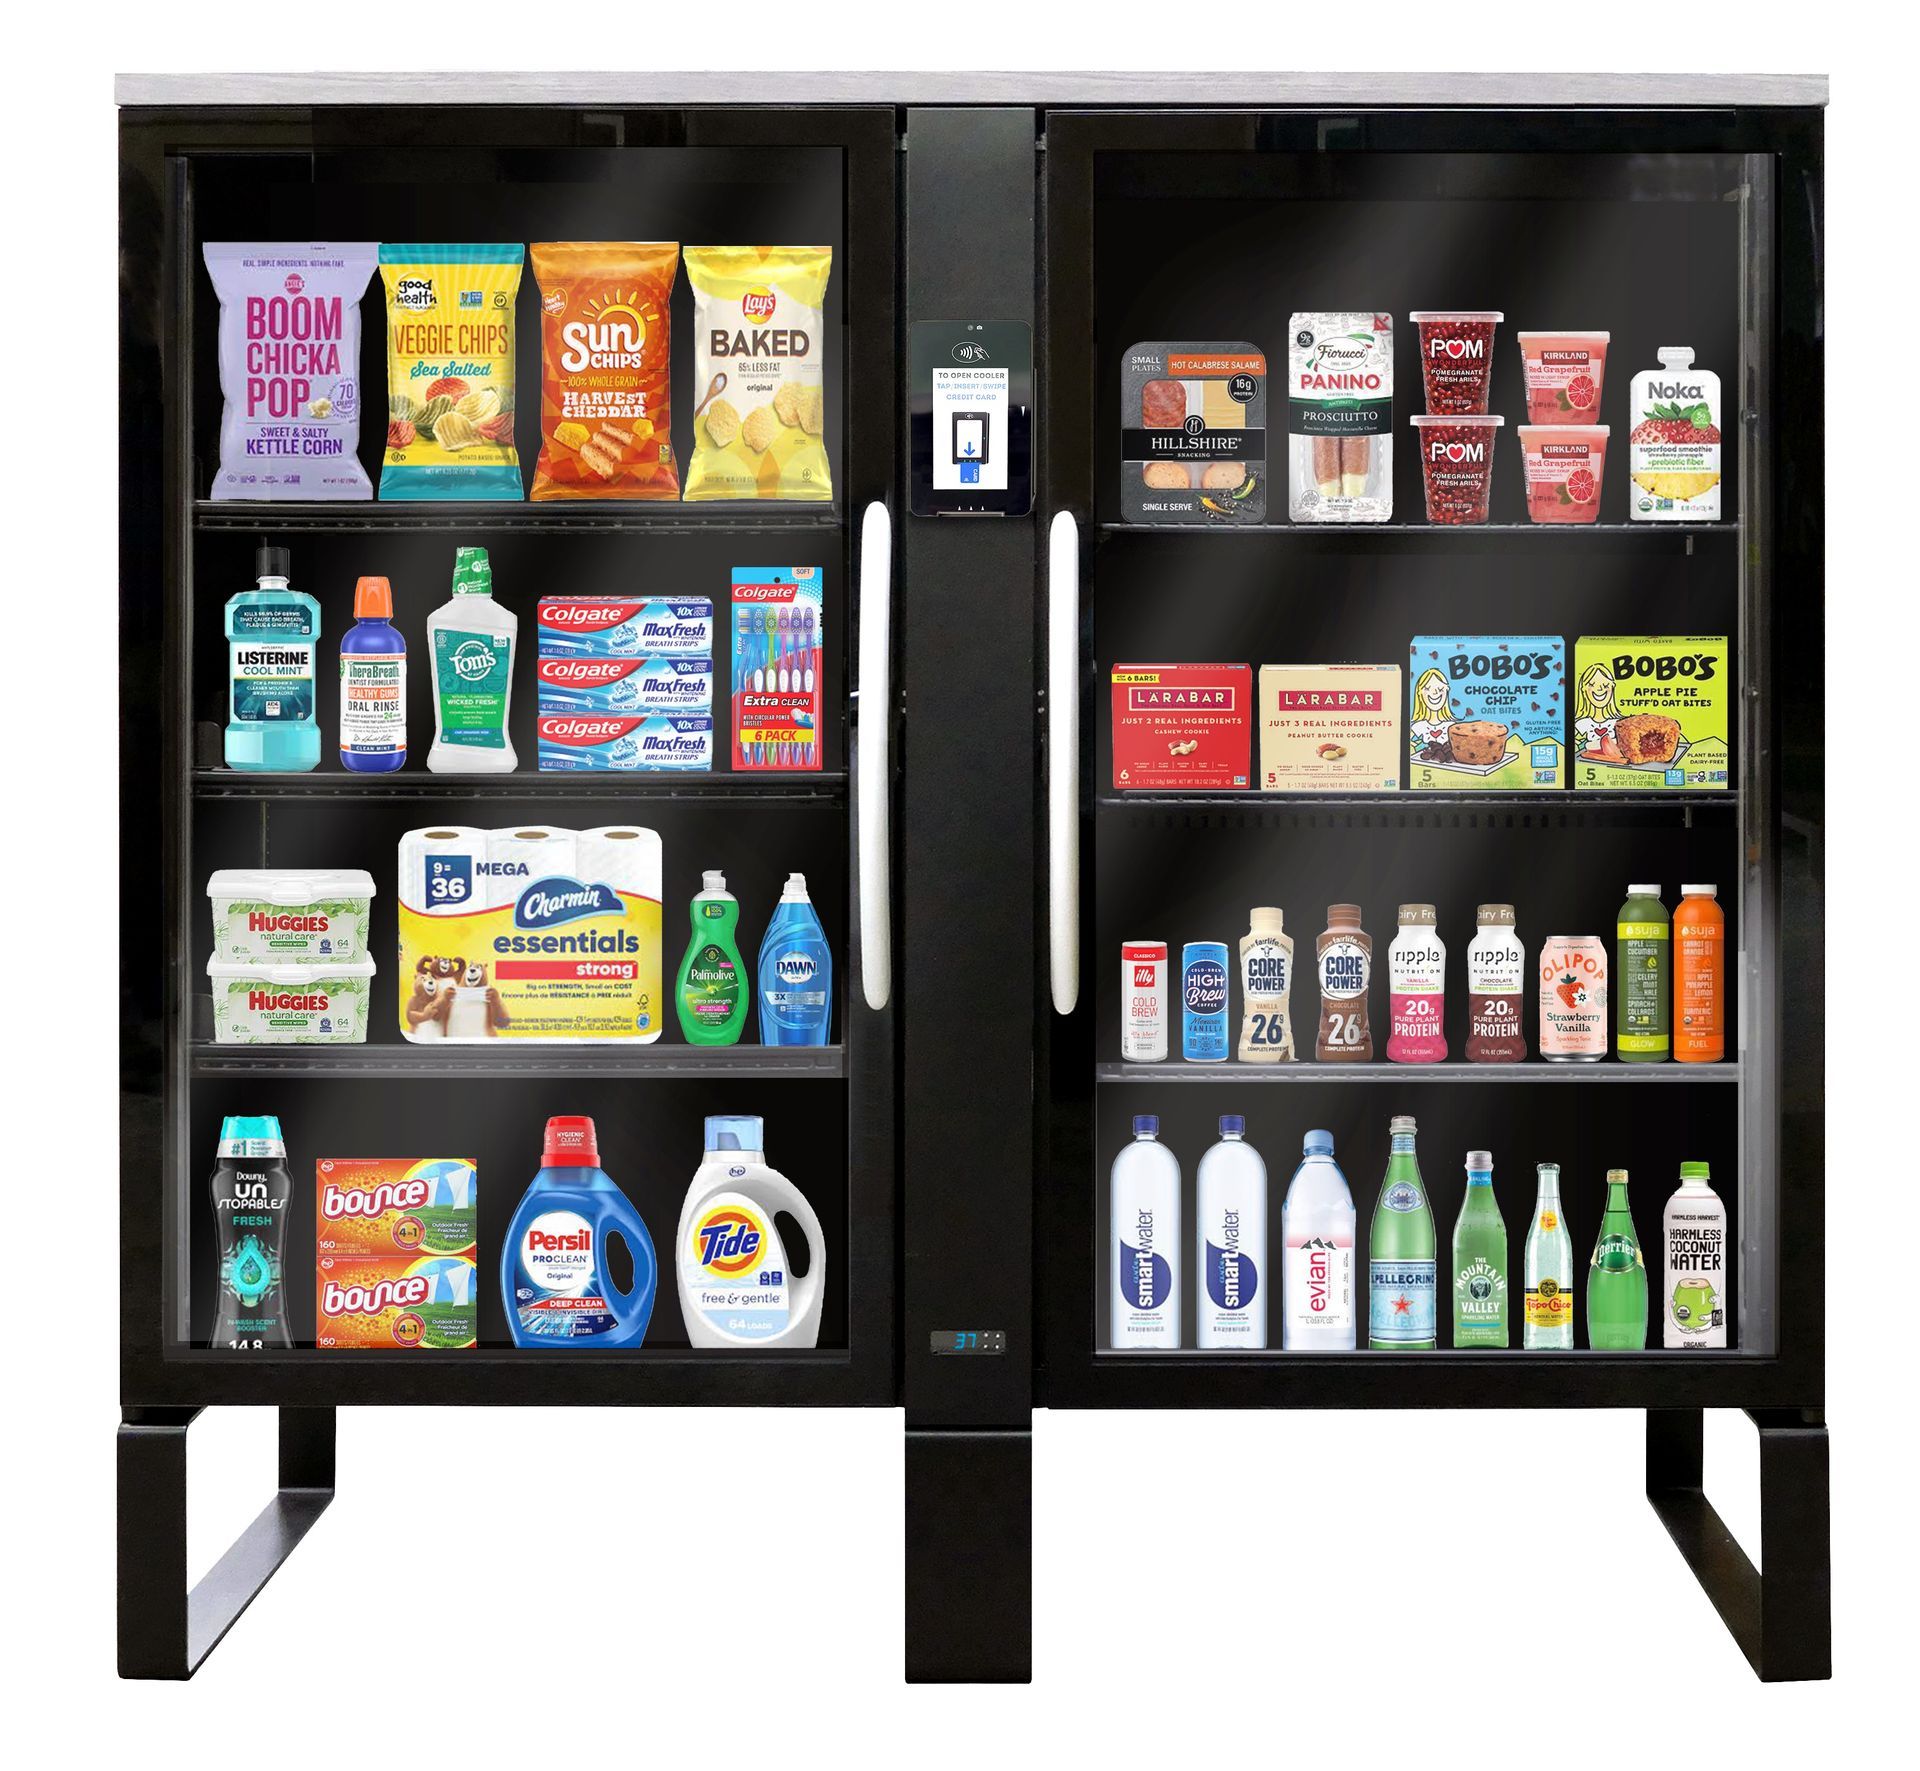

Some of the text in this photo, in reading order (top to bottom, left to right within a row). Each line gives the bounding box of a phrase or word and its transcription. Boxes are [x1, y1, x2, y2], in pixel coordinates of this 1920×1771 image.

[399, 280, 432, 293] good
[396, 291, 437, 304] health
[247, 296, 341, 340] BOOM
[395, 325, 508, 354] VEGGIE CHIPS
[711, 330, 809, 357] BAKED
[562, 322, 646, 372] Sun
[1318, 345, 1365, 359] Fiorucci
[1431, 338, 1483, 359] POM
[247, 343, 340, 375] CHICKA
[591, 353, 642, 368] CHIPS
[410, 361, 491, 379] Sea Salted
[739, 363, 780, 372] 65% LESS FAT
[1544, 366, 1590, 374] Grapefruit
[568, 376, 638, 386] 100% WHOLE GRAIN
[1301, 375, 1381, 390] PANINO
[340, 384, 353, 399] 70
[747, 384, 773, 392] original
[1649, 382, 1703, 399] Noka
[248, 377, 310, 417] POP
[563, 392, 646, 405] HARVEST
[562, 406, 646, 418] CHEDDAR
[1303, 411, 1378, 421] PROSCIUTTO
[261, 427, 328, 438] SWEET & SALTY
[247, 439, 342, 454] KETTLE CORN
[1432, 442, 1483, 463] POM
[1544, 445, 1588, 453] KIRKLAND
[1544, 460, 1590, 468] Grapefruit
[734, 587, 792, 599] Colgate
[543, 606, 621, 624] Colgate
[238, 652, 308, 665] LISTERINE
[244, 667, 303, 675] COOL MINT
[543, 662, 621, 680] Colgate
[349, 688, 399, 699] HEALTHY GUMS
[1465, 686, 1537, 694] CHOCOLATE
[1634, 688, 1697, 696] APPLE PIE
[348, 701, 399, 711] ORAL RINSE
[744, 696, 778, 705] Extra
[1486, 697, 1517, 705] CHIP
[543, 720, 621, 738] Colgate
[755, 731, 796, 741] 6 PACK
[1120, 770, 1129, 779] 6
[1268, 773, 1276, 783] 5
[1423, 770, 1431, 782] 5
[1587, 769, 1595, 779] 5
[476, 862, 529, 876] MEGA
[432, 878, 465, 897] 36
[524, 884, 600, 919] Charmin
[1635, 926, 1659, 936] suja
[1691, 926, 1715, 937] suja
[493, 930, 639, 953] essentials
[1395, 947, 1440, 964] ripple
[1474, 947, 1518, 964] ripple
[577, 963, 633, 978] strong
[777, 962, 816, 975] DAWN
[1248, 958, 1285, 976] CORE
[1326, 957, 1363, 975] CORE
[1543, 954, 1604, 981] OLIPOP
[692, 969, 734, 981] Palmolive
[1136, 969, 1153, 985] illy
[1188, 975, 1224, 986] HIGH
[1249, 978, 1284, 991] POWER
[1326, 976, 1362, 989] POWER
[1133, 997, 1156, 1007] COLD
[1187, 986, 1225, 1006] Brew
[1132, 1008, 1158, 1017] BREW
[1406, 1001, 1434, 1015] 20g
[1485, 1001, 1513, 1015] 20g
[1547, 1013, 1600, 1022] Strawberry
[1395, 1023, 1439, 1037] PROTEIN
[1474, 1023, 1518, 1037] PROTEIN
[1556, 1024, 1591, 1032] Vanilla
[231, 1141, 247, 1156] #1
[325, 1181, 424, 1216] bounce
[233, 1216, 272, 1226] FRESH
[529, 1230, 591, 1250] Persil
[1670, 1229, 1721, 1240] HARMLESS
[701, 1225, 760, 1265] Tide
[1670, 1241, 1722, 1253] COCONUT
[1670, 1254, 1721, 1270] WATER
[1456, 1265, 1505, 1290] MOUNTAIN
[325, 1278, 424, 1312] bounce
[702, 1293, 780, 1305] free & gentle
[1462, 1302, 1500, 1312] VALLEY
[955, 1334, 976, 1349] 37
